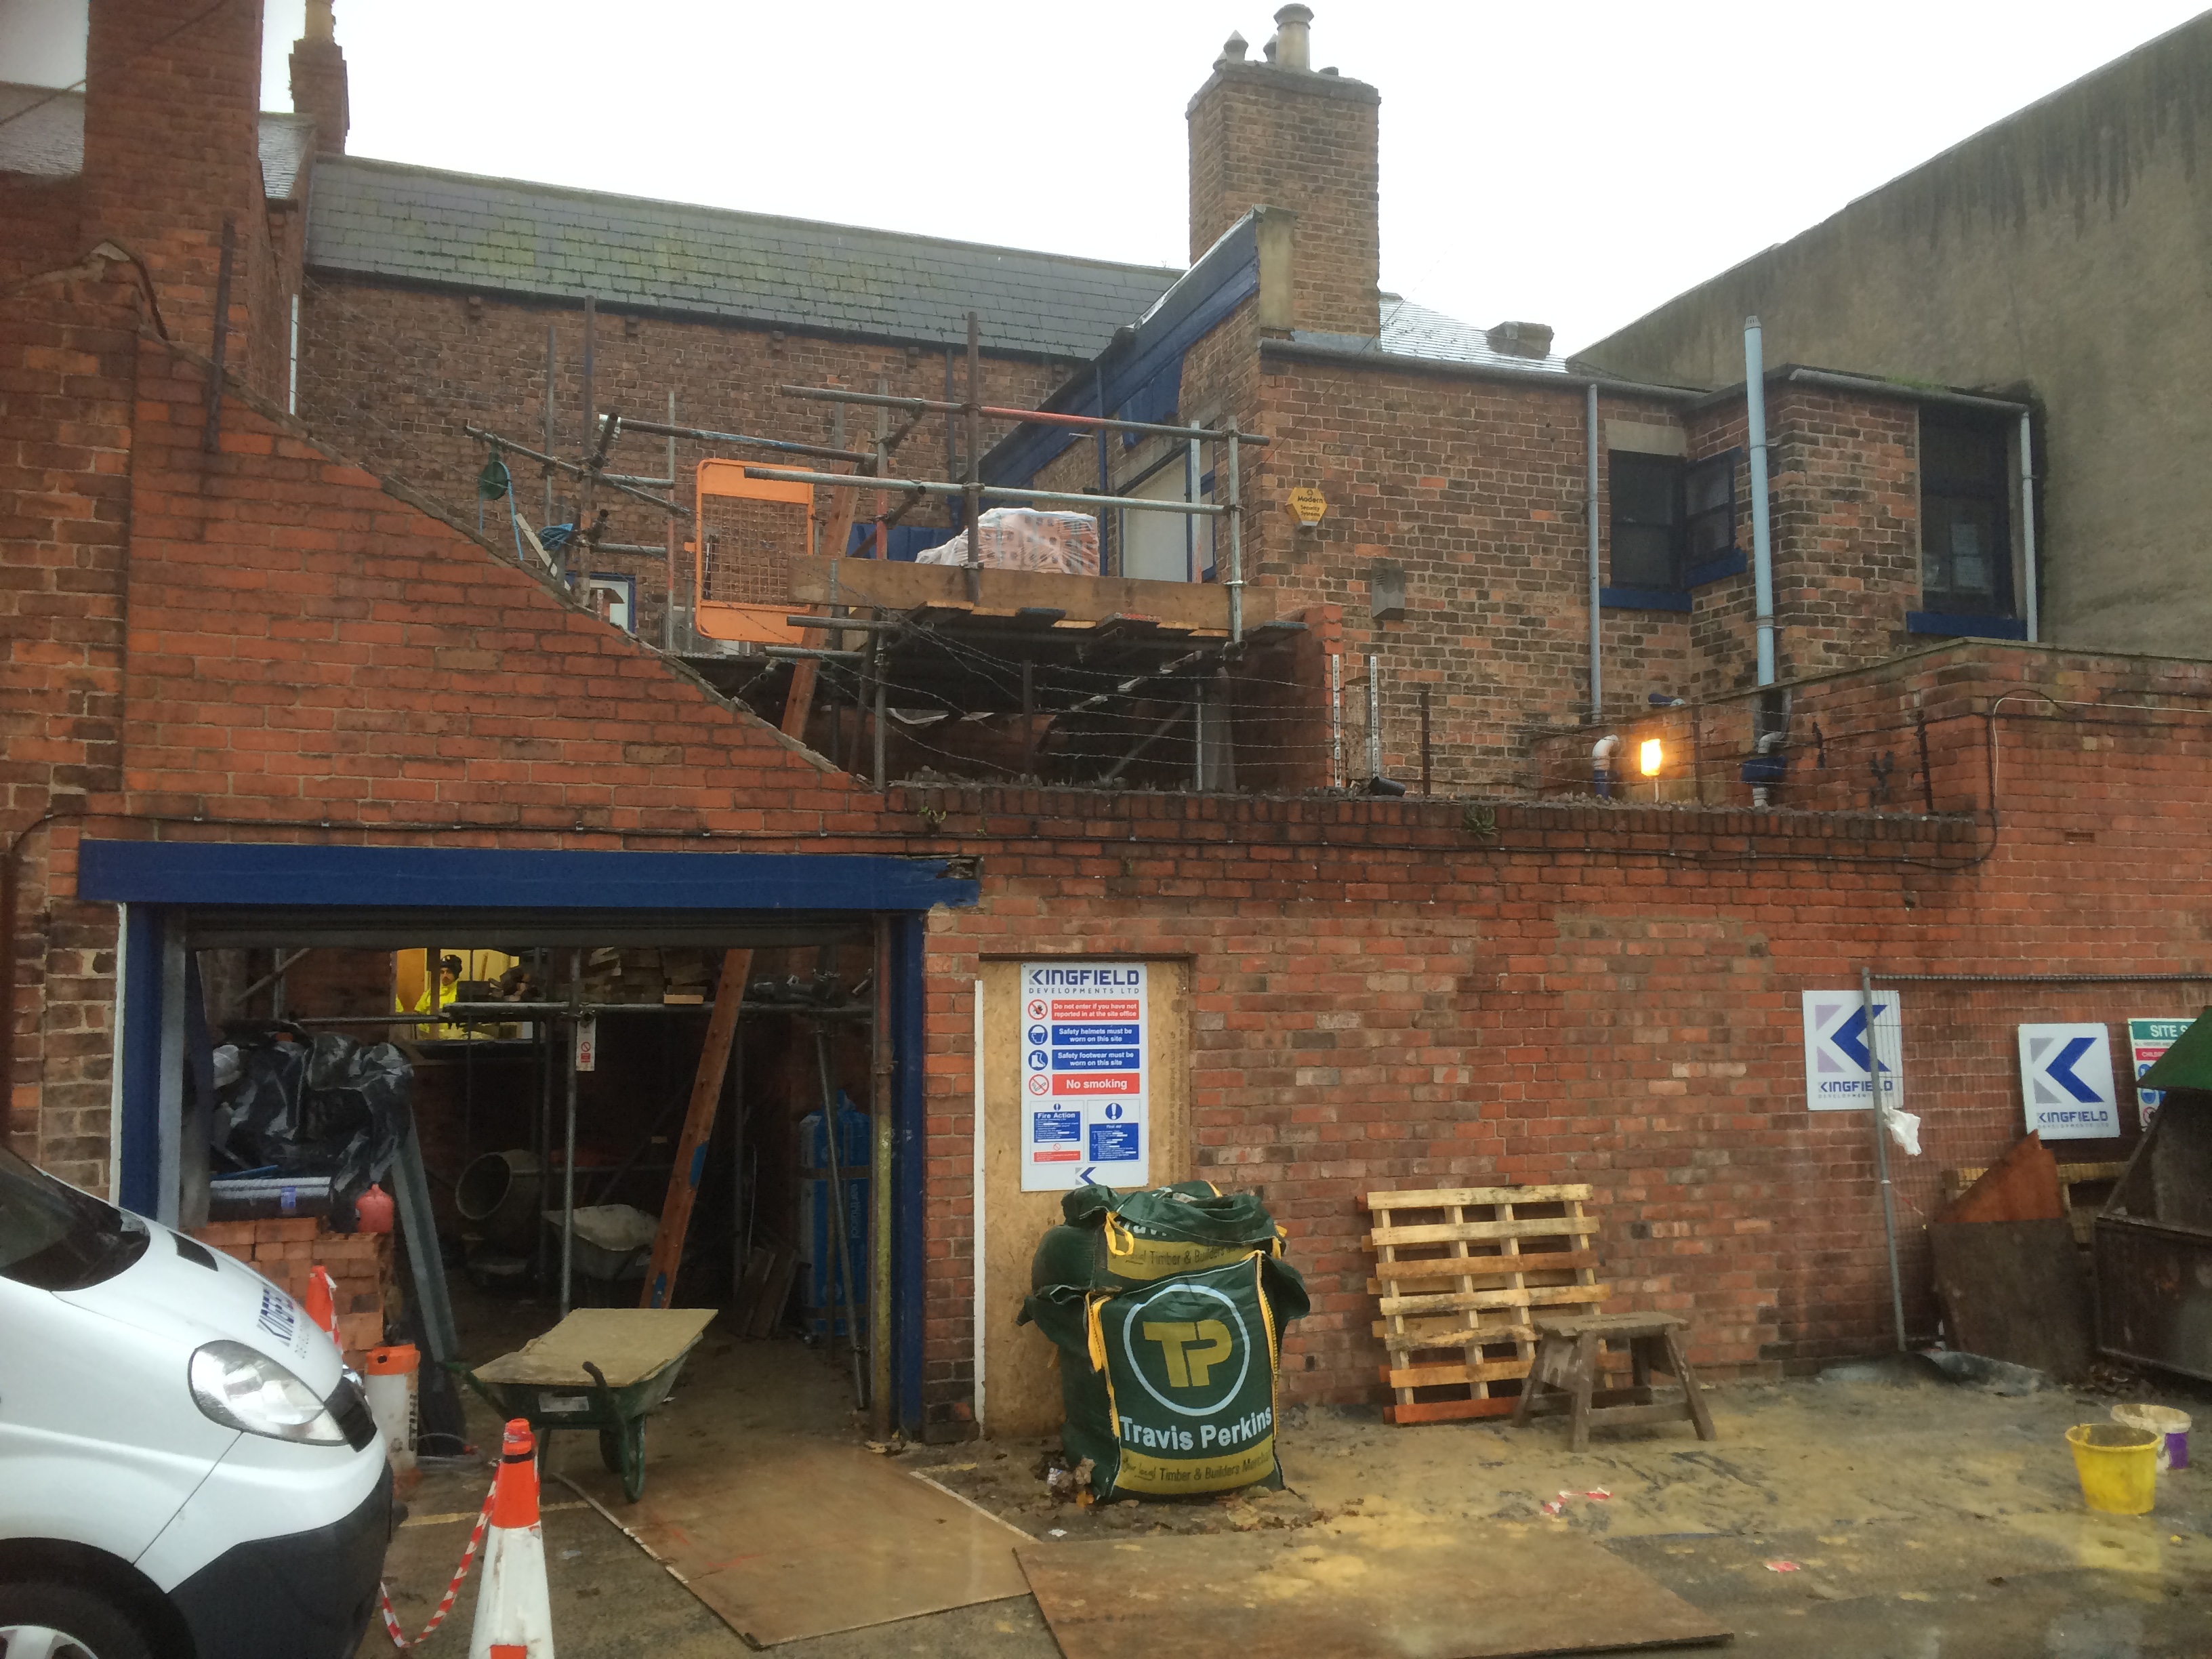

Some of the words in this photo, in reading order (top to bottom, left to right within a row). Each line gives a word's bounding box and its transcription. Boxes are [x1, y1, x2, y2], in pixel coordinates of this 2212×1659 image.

[1297, 495, 1323, 504] Modern
[1029, 969, 1139, 985] KINGFIELD
[2150, 1025, 2178, 1038] SITE
[1066, 1080, 1081, 1089] No
[1083, 1079, 1128, 1090] smoking
[1818, 1080, 1893, 1092] KINGFIED
[2036, 1111, 2108, 1123] KINGFIELD
[1150, 1250, 1181, 1265] Timber
[1183, 1250, 1191, 1265] &
[1195, 1246, 1225, 1263] Builders
[1143, 1319, 1232, 1388] TP
[1119, 1416, 1194, 1451] Travis
[1200, 1406, 1273, 1449] Perkins
[1160, 1467, 1191, 1481] Timber
[1193, 1467, 1202, 1481] &
[1205, 1465, 1240, 1480] Builders
